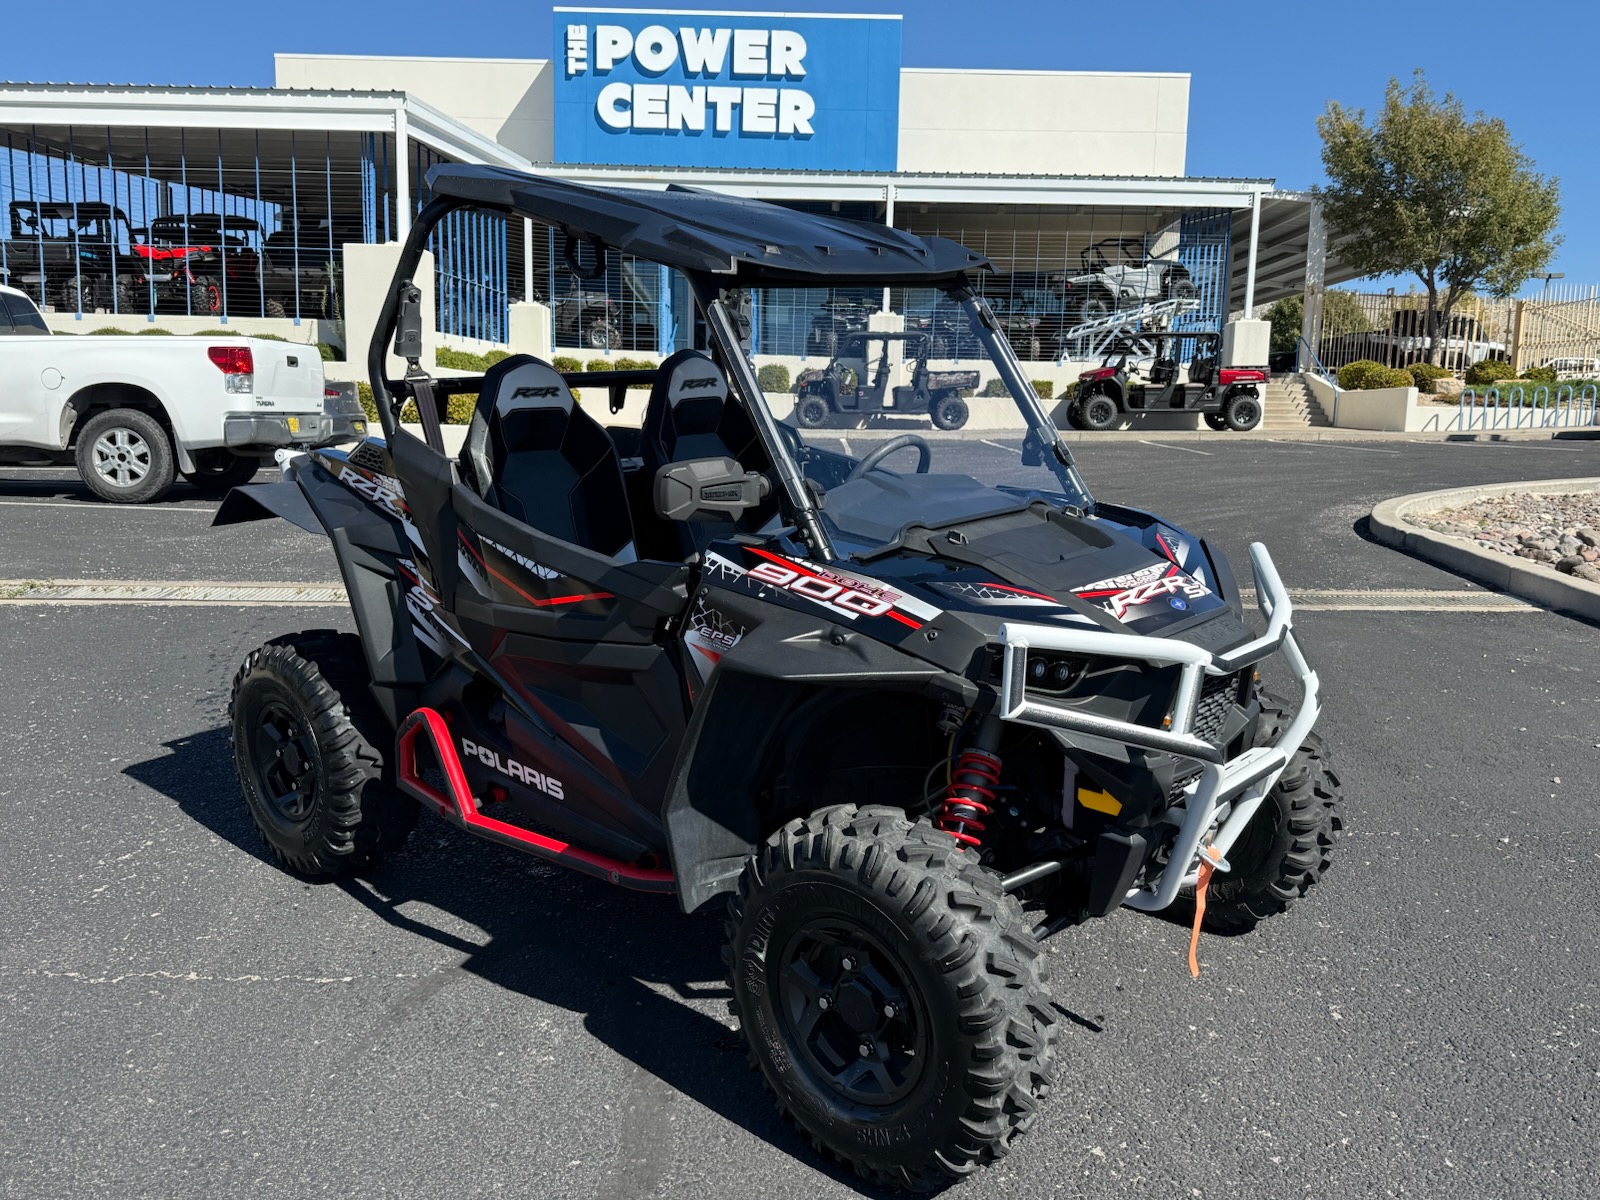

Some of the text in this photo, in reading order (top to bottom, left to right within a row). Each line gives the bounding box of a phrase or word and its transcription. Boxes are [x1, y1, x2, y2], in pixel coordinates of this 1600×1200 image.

[567, 24, 588, 75] THE
[595, 24, 808, 76] POWER
[596, 82, 816, 135] CENTER
[510, 386, 561, 400] RZR
[679, 377, 718, 392] RZR
[338, 466, 398, 513] RZR
[746, 562, 894, 617] 900
[1109, 575, 1191, 620] RZR
[700, 626, 736, 646] EPS
[461, 737, 565, 801] POLARIS
